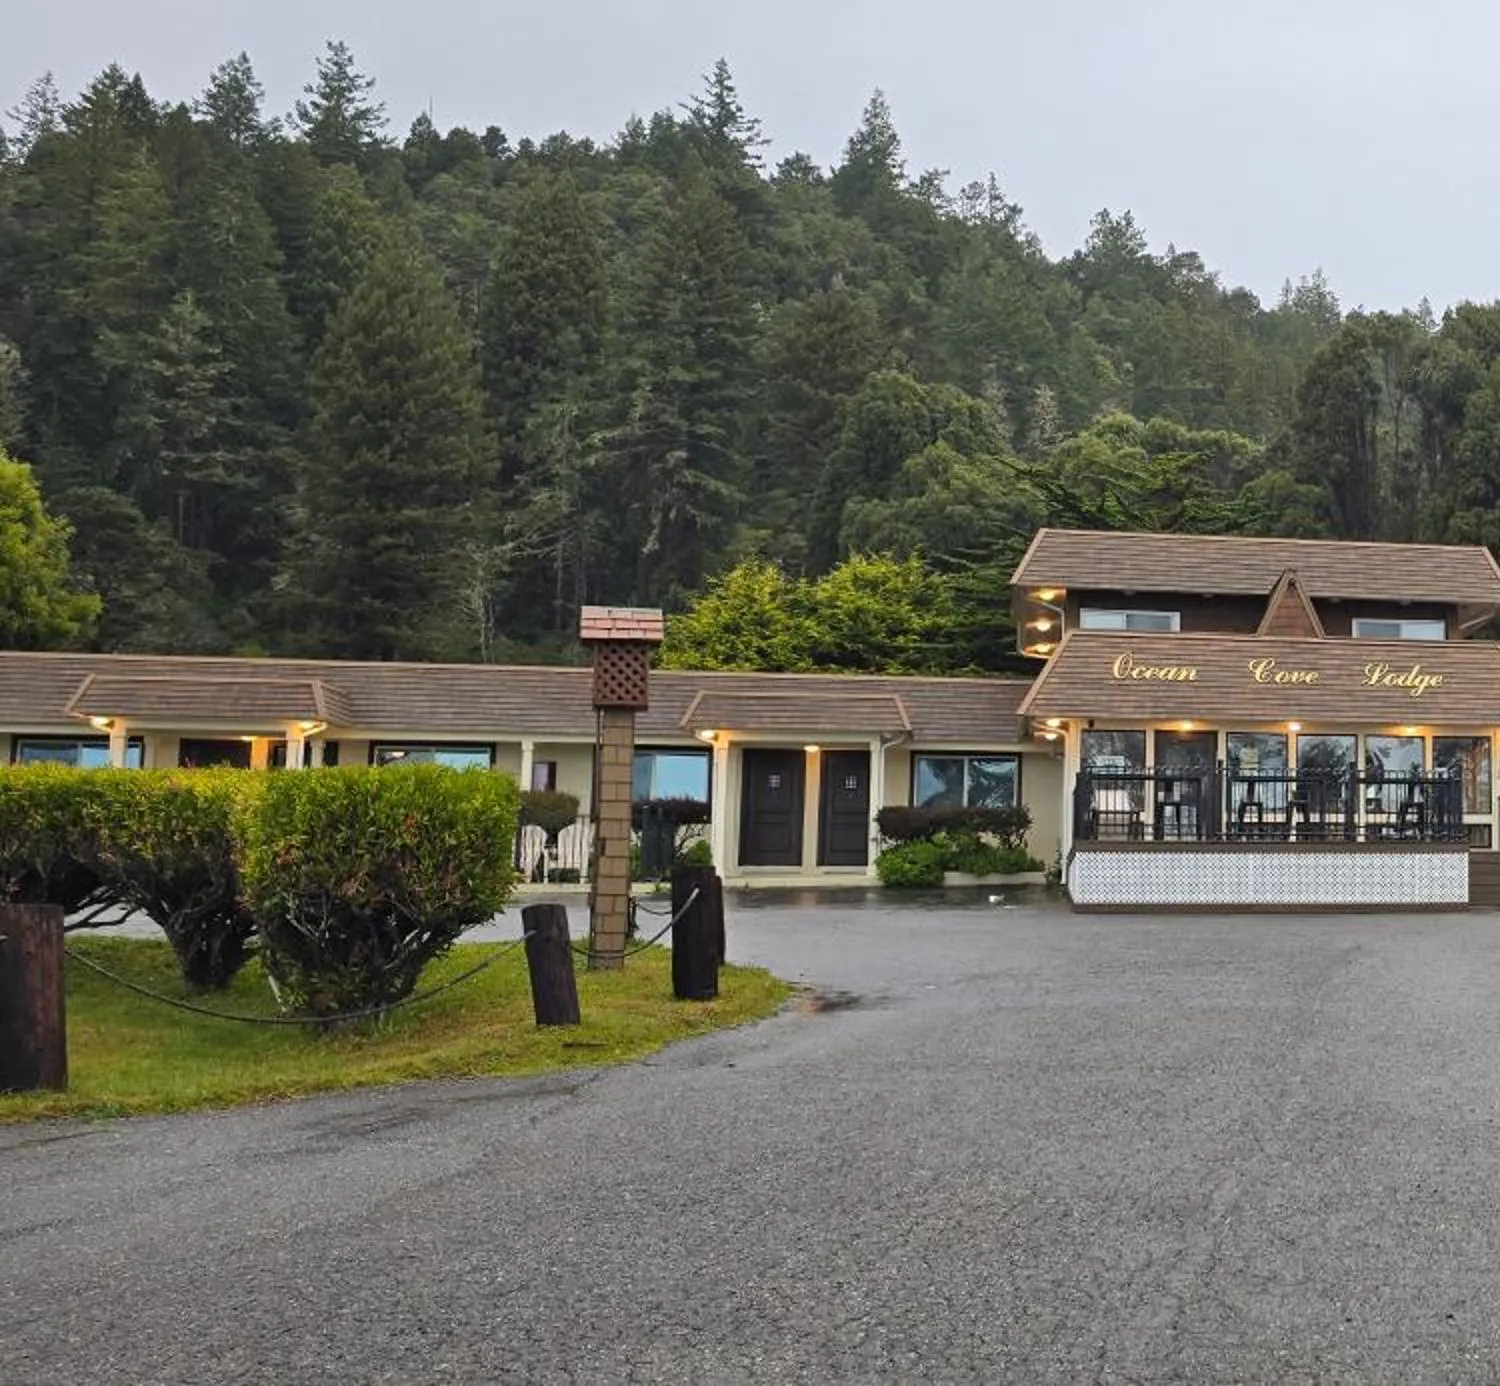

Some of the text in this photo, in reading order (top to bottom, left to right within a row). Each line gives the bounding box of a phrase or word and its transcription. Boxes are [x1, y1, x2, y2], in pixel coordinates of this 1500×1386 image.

[1113, 651, 1444, 697] Ocean Cove Lodge
